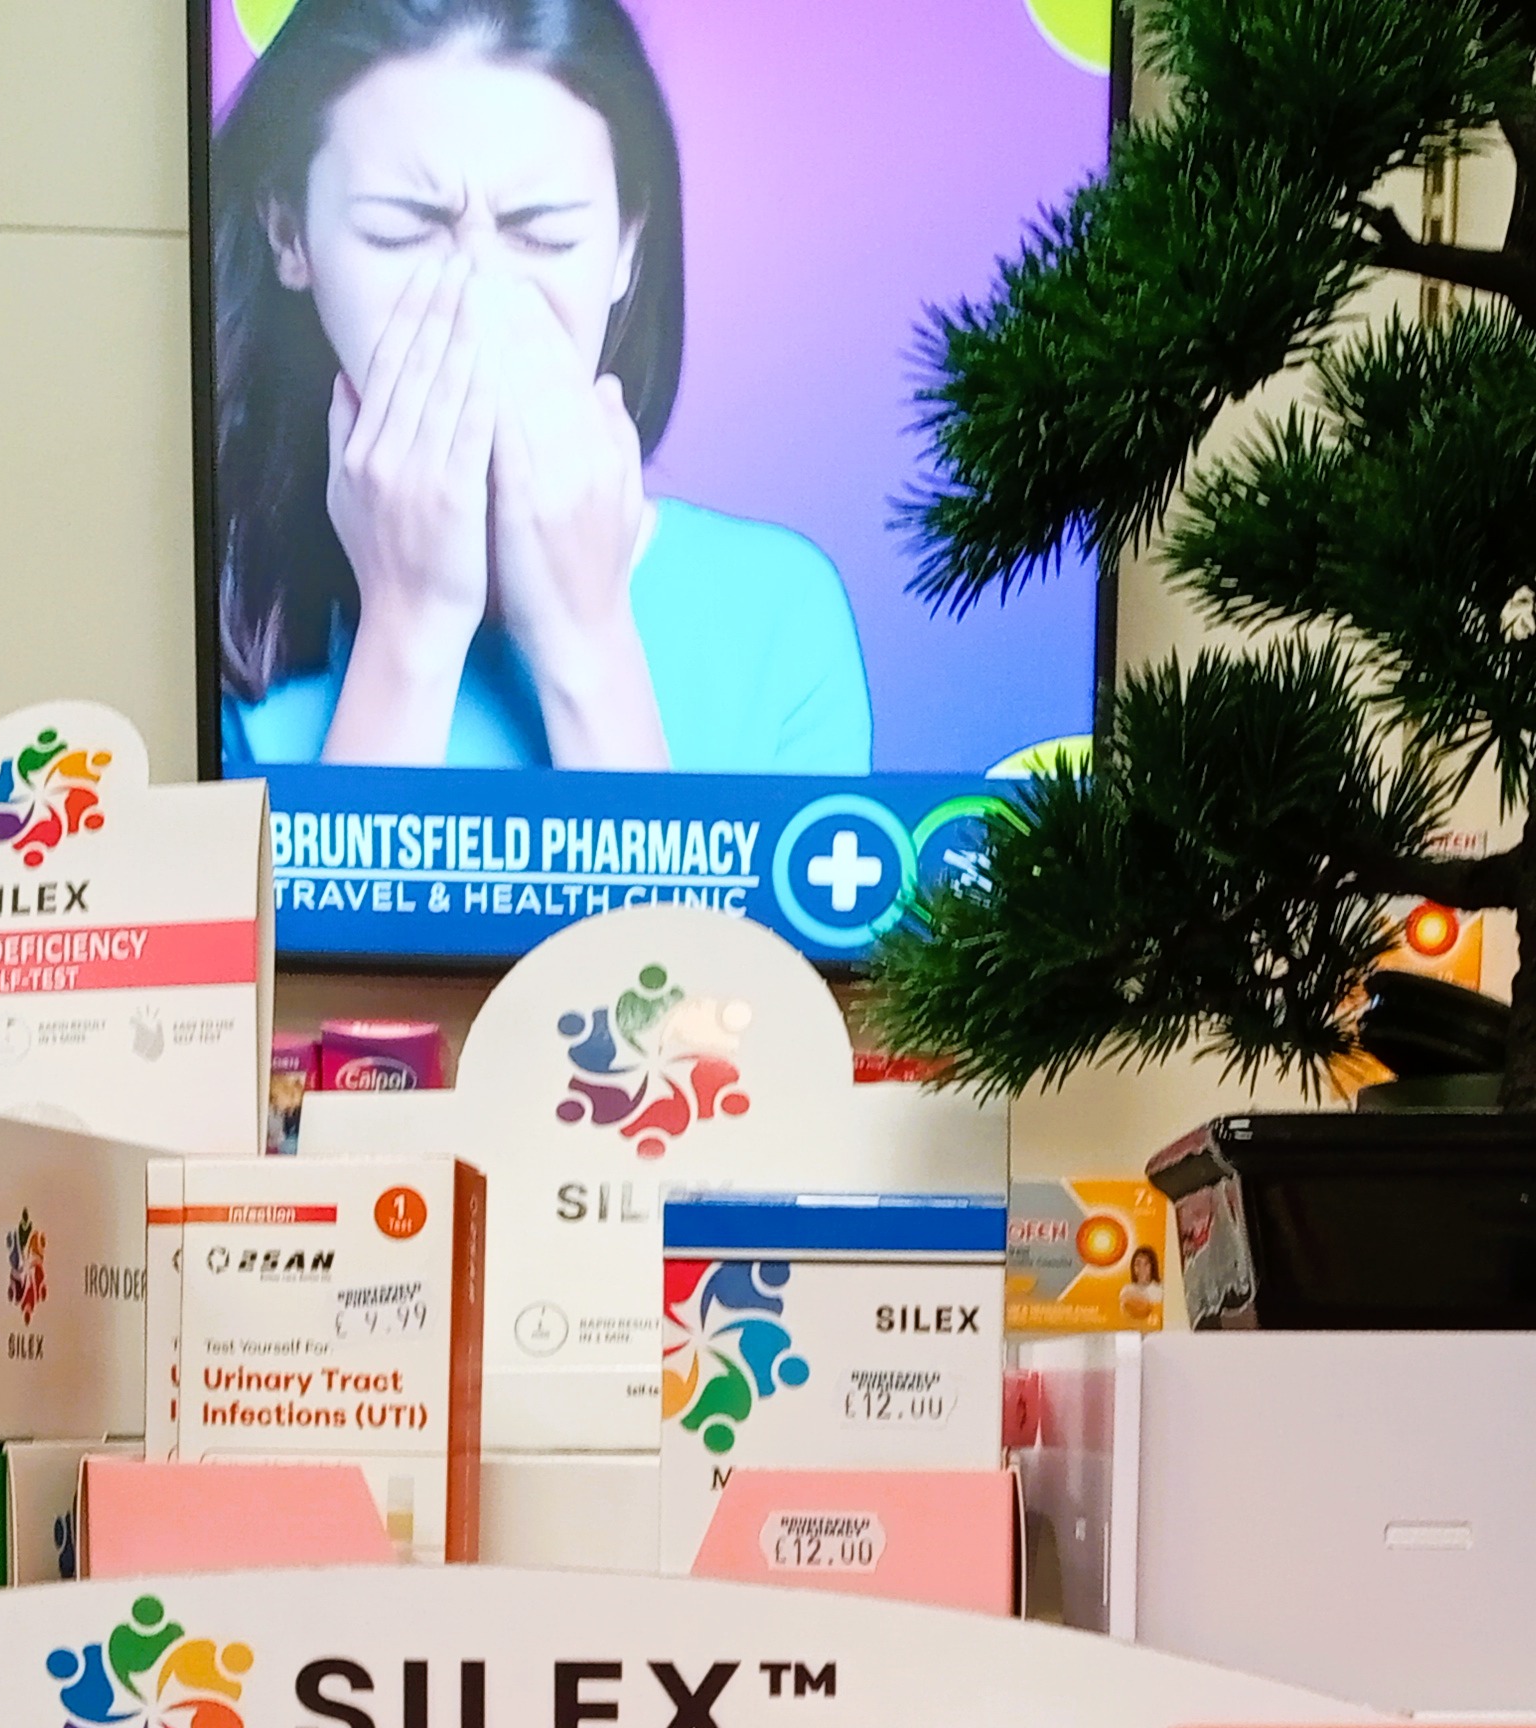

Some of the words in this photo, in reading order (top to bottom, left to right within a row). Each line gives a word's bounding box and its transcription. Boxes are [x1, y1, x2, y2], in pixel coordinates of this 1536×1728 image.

[270, 811, 530, 871] BRUNTSFIELD
[542, 820, 760, 874] PHARMACY
[272, 881, 416, 914] TRAVEL
[427, 883, 451, 910] &
[464, 883, 608, 915] HEALTH
[392, 1193, 407, 1220] 1
[83, 1262, 121, 1301] IRON
[875, 1304, 982, 1335] SILEX
[202, 1365, 313, 1396] Urinary
[320, 1366, 404, 1394] Tract
[202, 1400, 348, 1428] Infections
[354, 1401, 429, 1431] (UTI)
[842, 1392, 945, 1422] £12.00
[773, 1536, 874, 1566] £12.00
